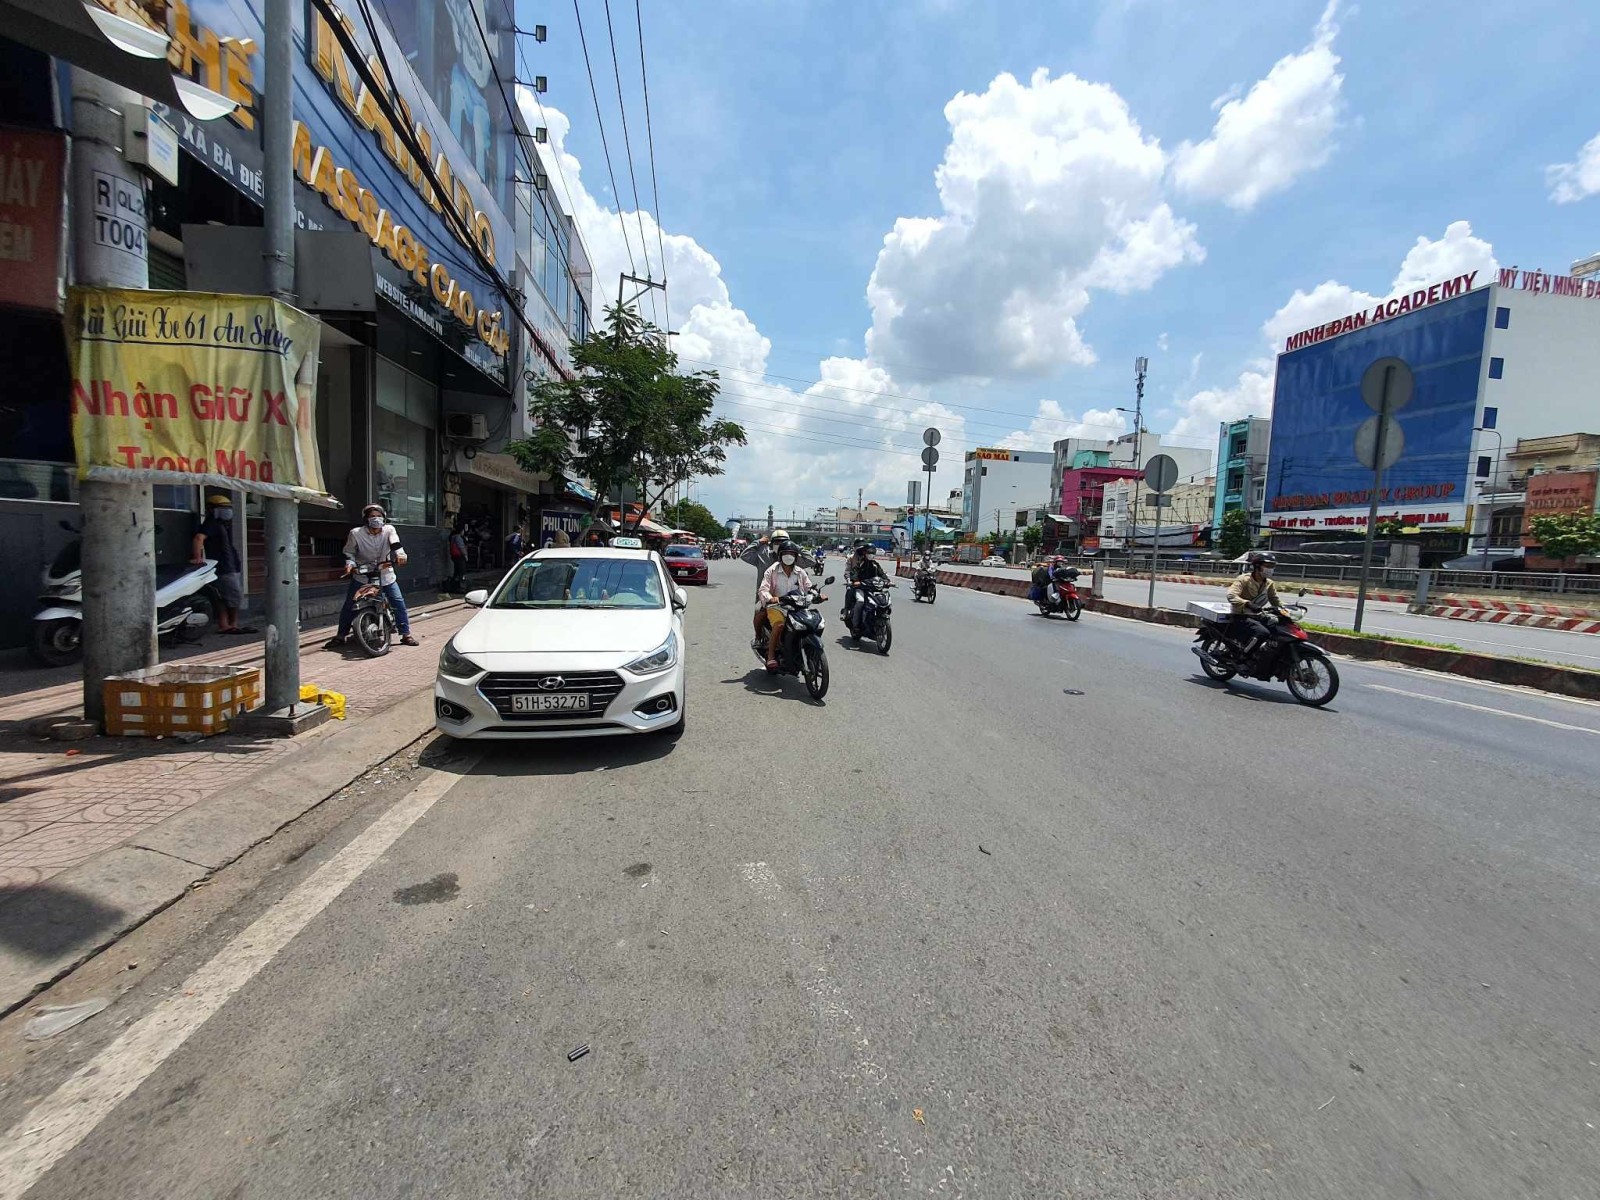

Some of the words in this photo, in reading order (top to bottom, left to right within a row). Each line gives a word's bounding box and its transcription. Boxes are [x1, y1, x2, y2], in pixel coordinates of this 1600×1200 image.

[0, 141, 44, 208] ÁY
[181, 116, 208, 155] XÃ
[213, 142, 234, 175] BÀ
[239, 168, 265, 199] ĐIỂ
[98, 178, 111, 208] R
[431, 263, 476, 326] CAO
[1286, 324, 1326, 352] MINH
[1371, 269, 1480, 323] ACADEMY
[1552, 275, 1586, 297] MINH
[184, 311, 206, 340] 61
[214, 311, 244, 344] An
[71, 379, 179, 430] Nhận
[190, 384, 253, 423] Giữ
[562, 514, 582, 533] TÙN
